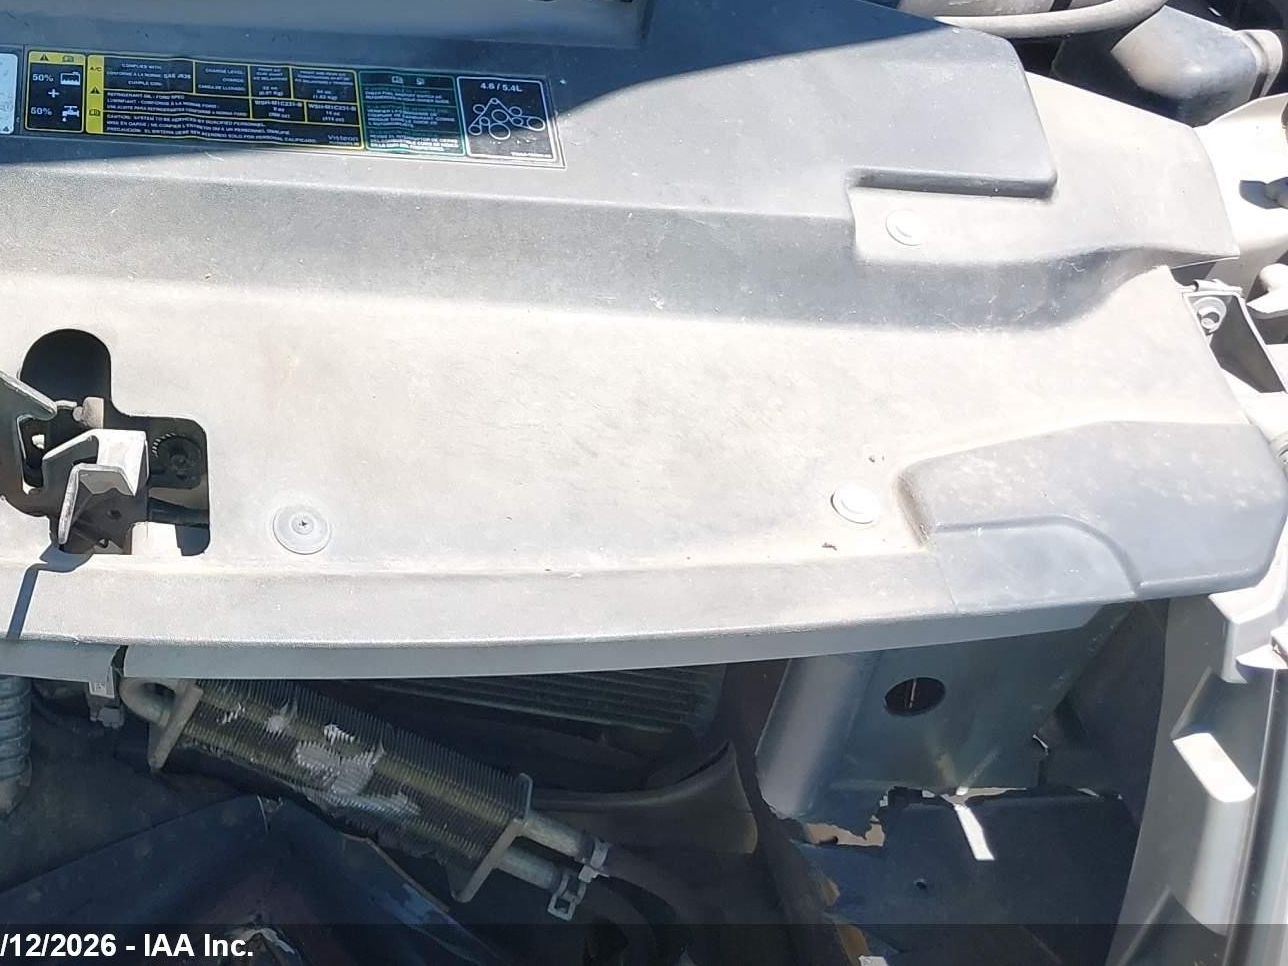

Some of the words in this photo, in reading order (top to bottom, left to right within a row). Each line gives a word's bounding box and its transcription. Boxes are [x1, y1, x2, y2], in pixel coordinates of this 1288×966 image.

[32, 73, 54, 82] 50%
[502, 84, 524, 92] 5.4L
[30, 107, 53, 115] 50%
[327, 134, 359, 142] Visteon
